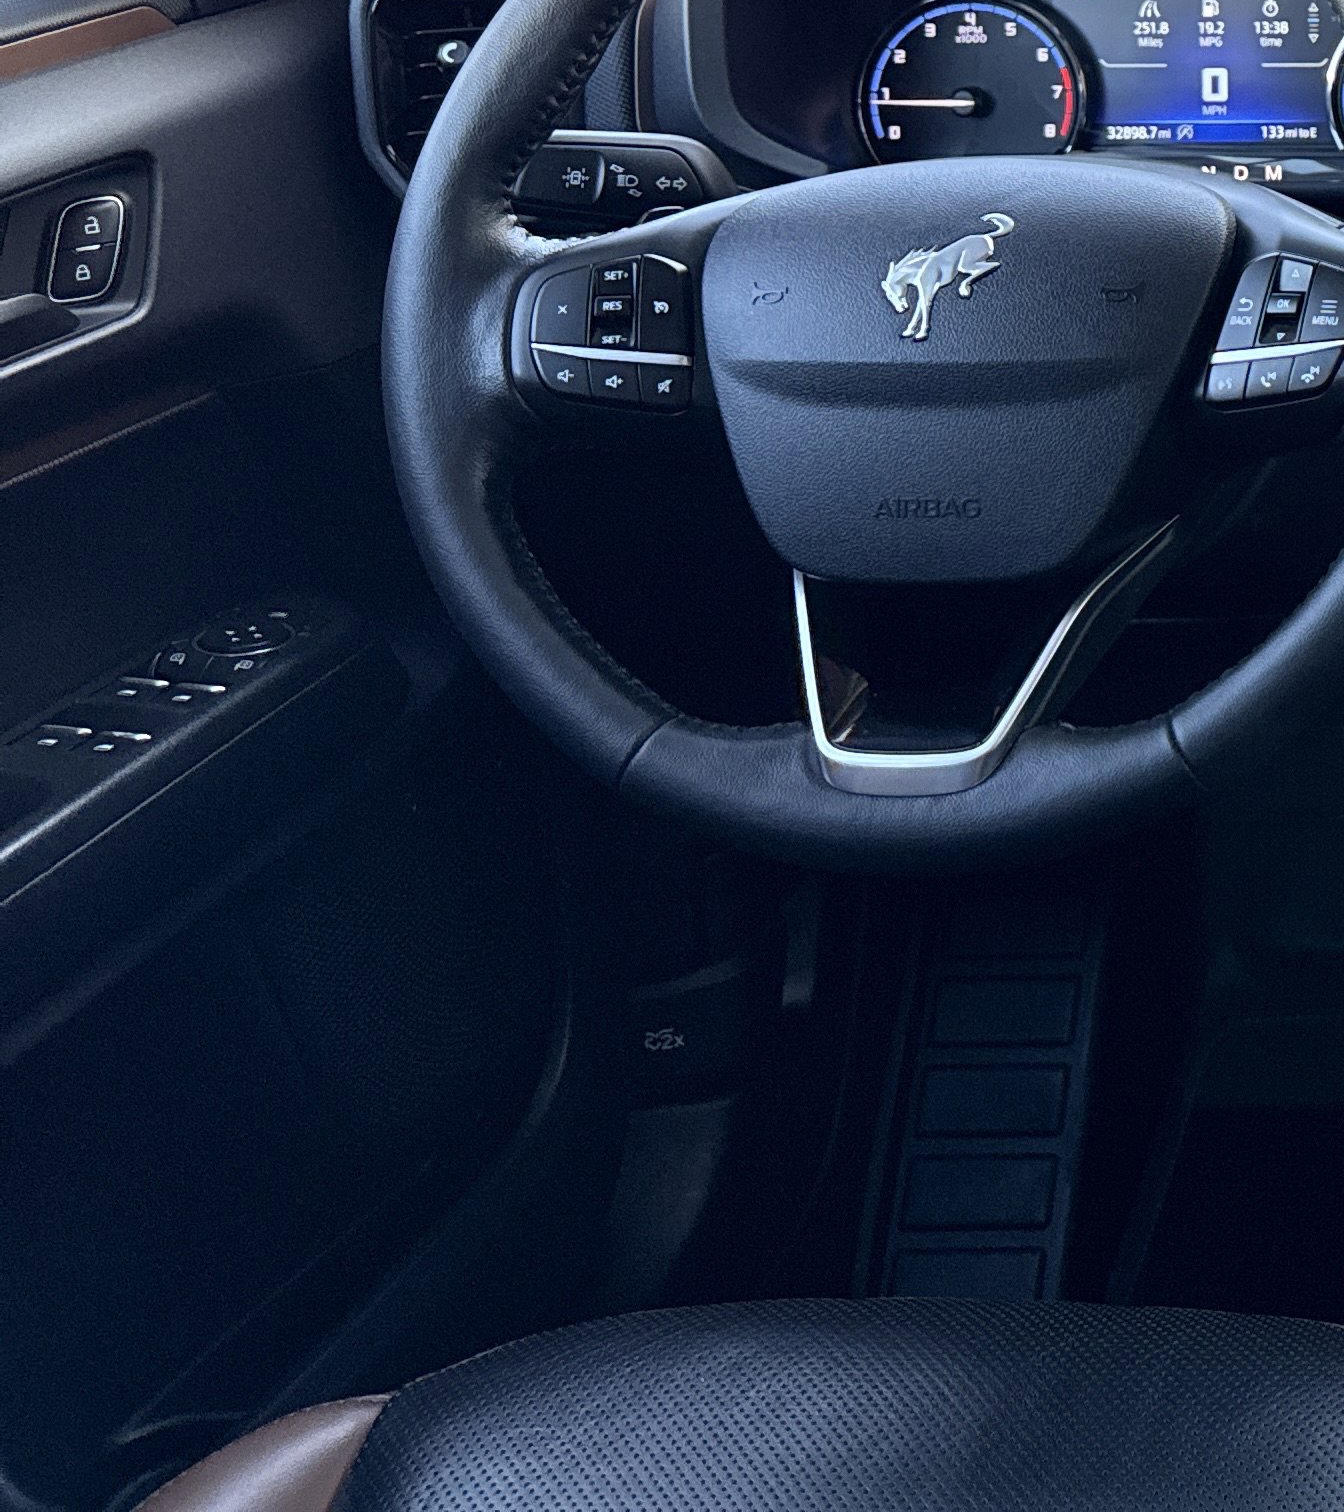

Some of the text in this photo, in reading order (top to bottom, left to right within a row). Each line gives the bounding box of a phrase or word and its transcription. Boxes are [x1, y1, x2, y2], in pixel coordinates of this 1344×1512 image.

[964, 12, 977, 26] 4
[924, 23, 937, 38] 3
[957, 25, 984, 35] RPM
[1004, 22, 1017, 37] 5
[1133, 21, 1289, 34] 251.8 19.2 13:38
[1138, 37, 1283, 49] Miles MPG time
[893, 49, 907, 64] 2
[1036, 48, 1049, 62] 6
[1201, 67, 1229, 102] 0
[1051, 85, 1063, 99] 7
[1202, 106, 1227, 116] MPH
[1107, 126, 1157, 139] 32898.7
[1261, 125, 1284, 138] 133
[1234, 164, 1283, 181] D M
[602, 301, 622, 311] RES
[1276, 299, 1290, 308] OK
[1230, 316, 1252, 326] BACK
[1312, 316, 1339, 326] MENU
[873, 495, 982, 519] AIRBAG
